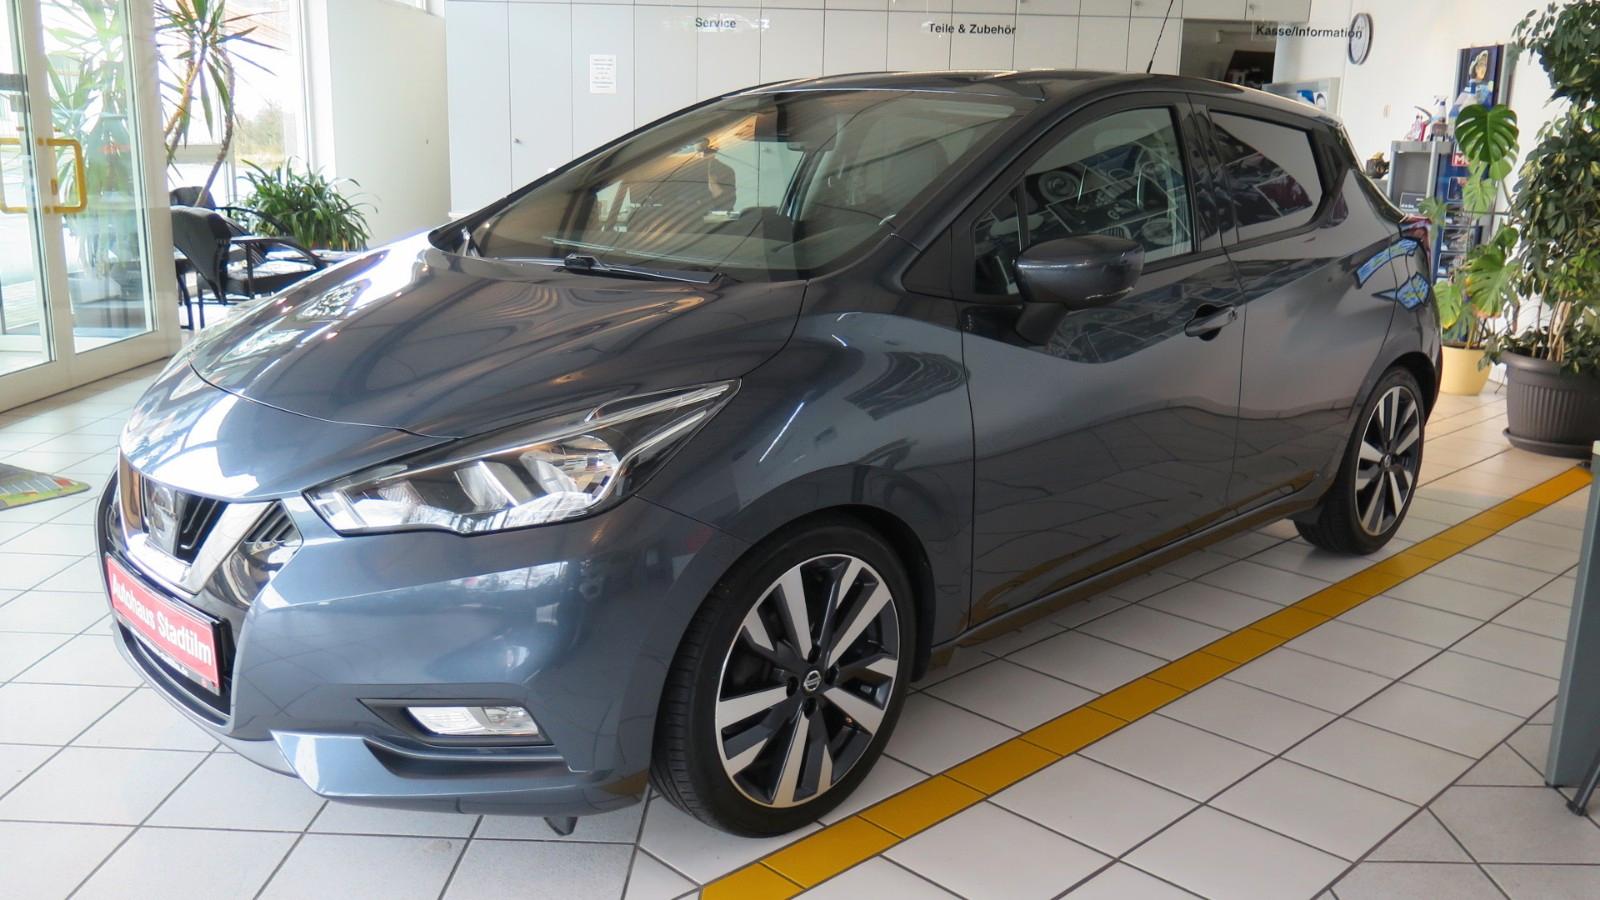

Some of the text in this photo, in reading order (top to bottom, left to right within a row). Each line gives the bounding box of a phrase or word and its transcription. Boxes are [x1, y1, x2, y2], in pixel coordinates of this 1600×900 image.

[695, 17, 737, 28] Service
[929, 23, 1016, 34] Teile & Zubehör
[1256, 25, 1363, 39] Kasse/Information
[111, 573, 156, 630] Autohaus
[156, 611, 212, 667] Stadtilm
